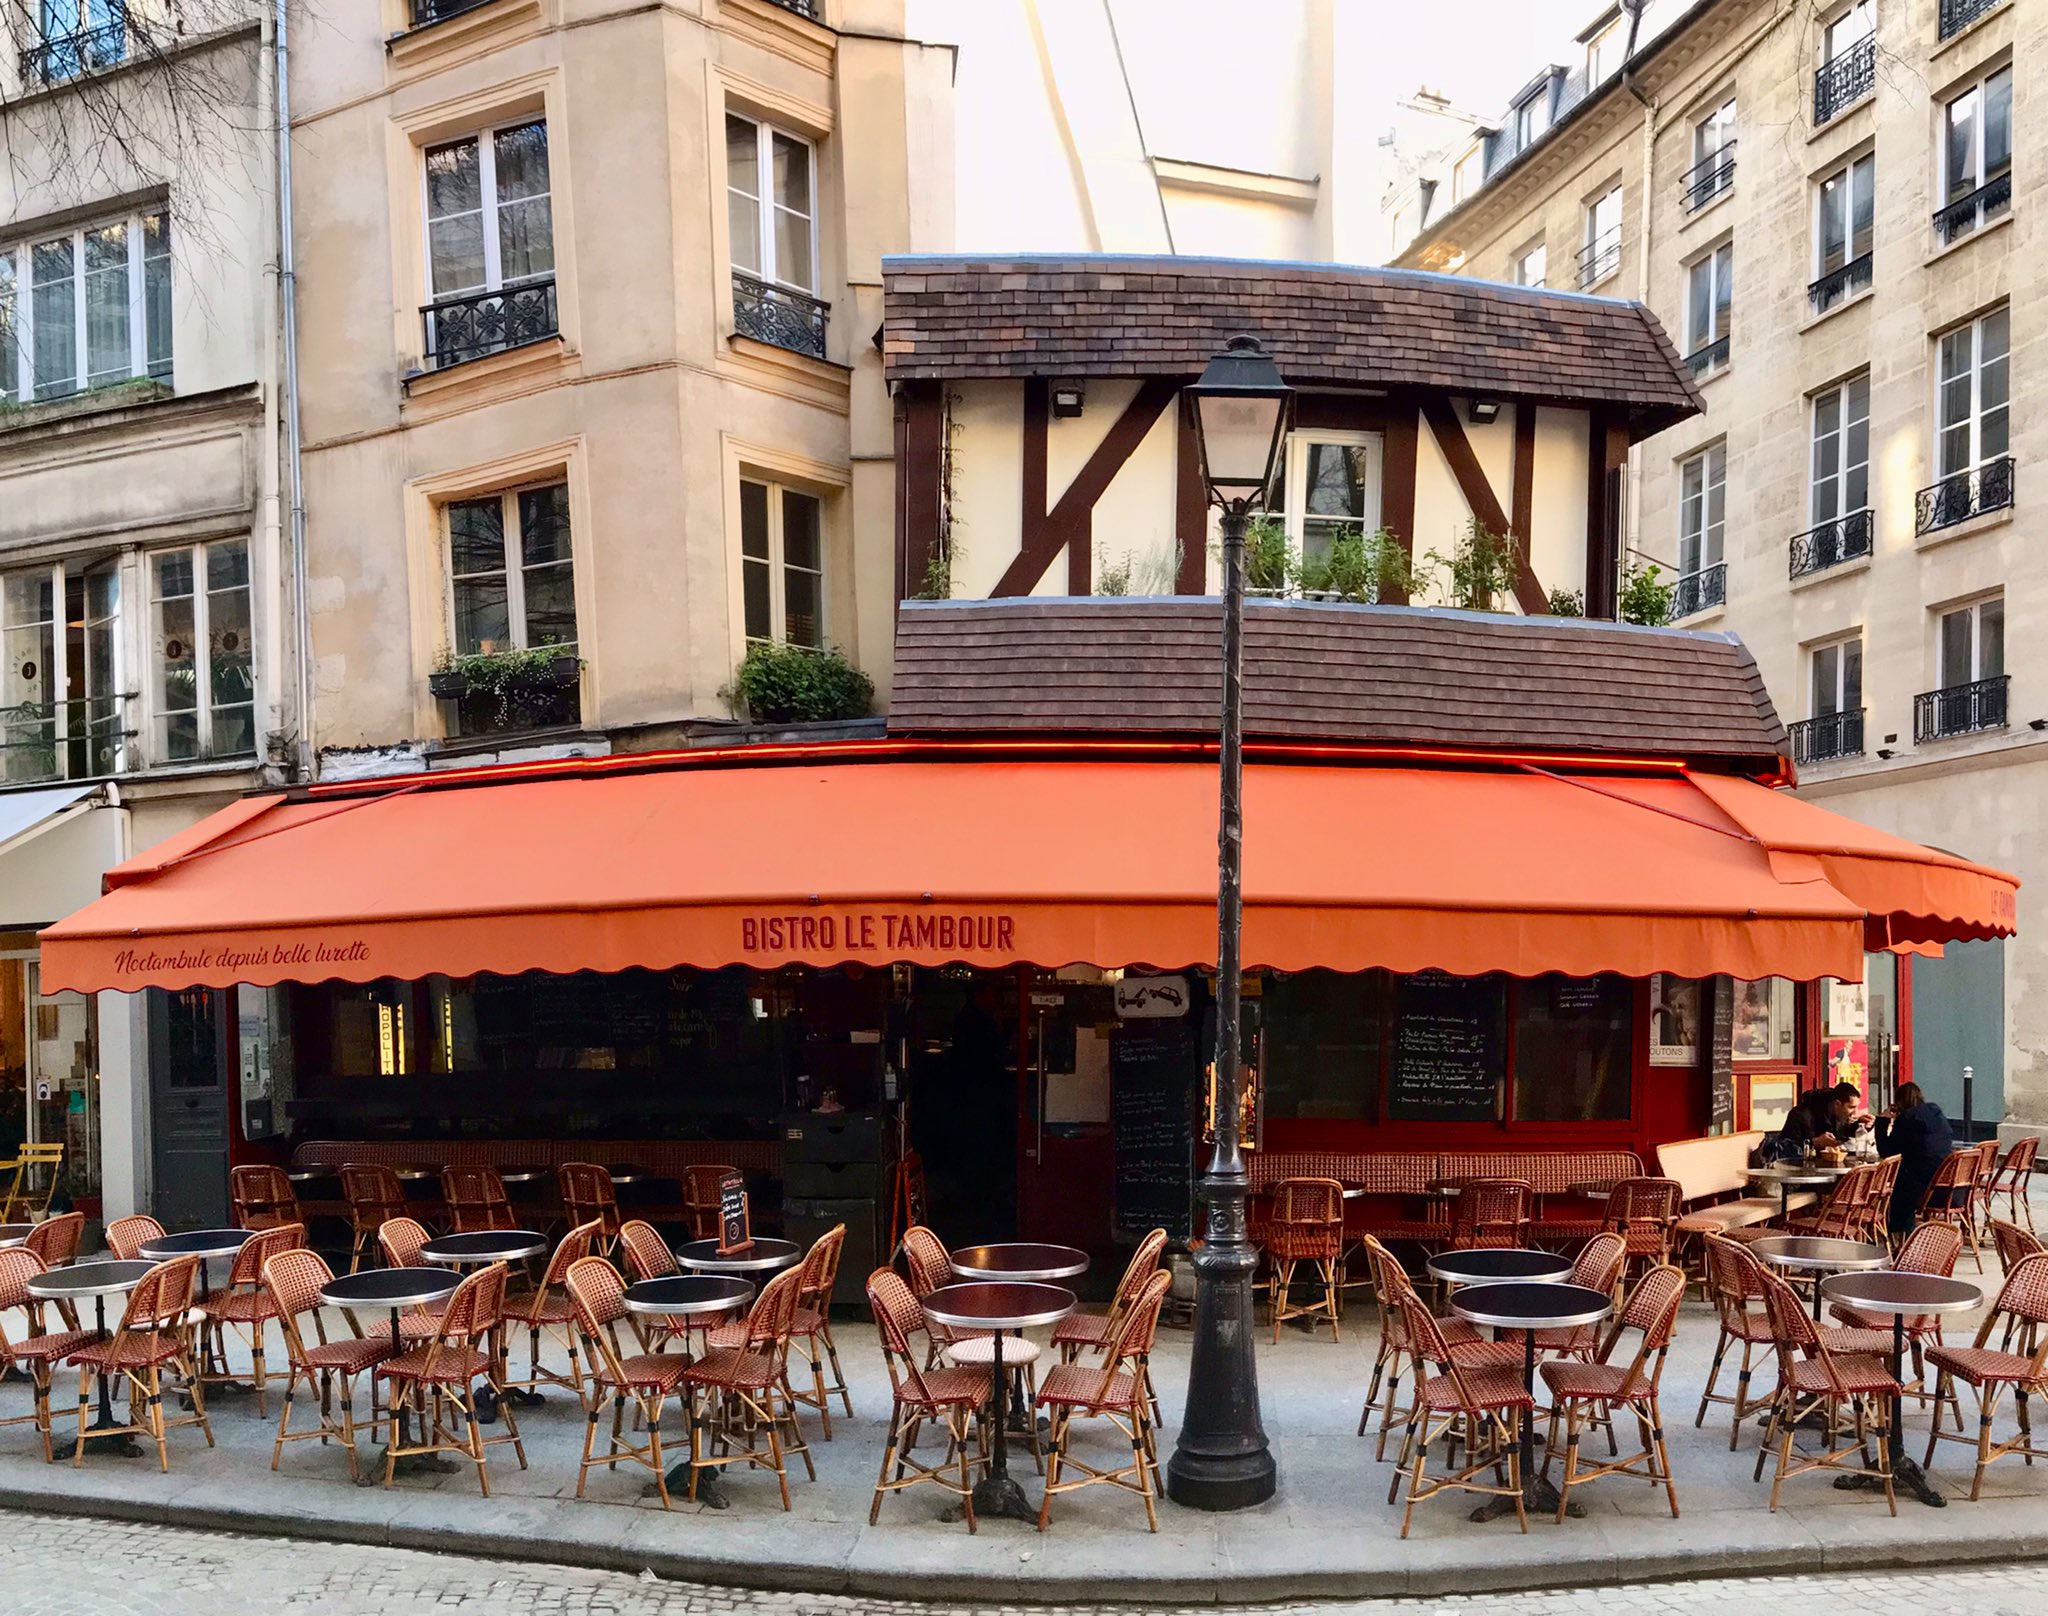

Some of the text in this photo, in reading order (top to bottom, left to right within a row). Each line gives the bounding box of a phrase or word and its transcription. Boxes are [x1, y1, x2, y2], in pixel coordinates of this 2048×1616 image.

[742, 914, 1015, 951] BISTRO LE TAMBOUR
[114, 940, 371, 975] Noctambule depuis belle lurette
